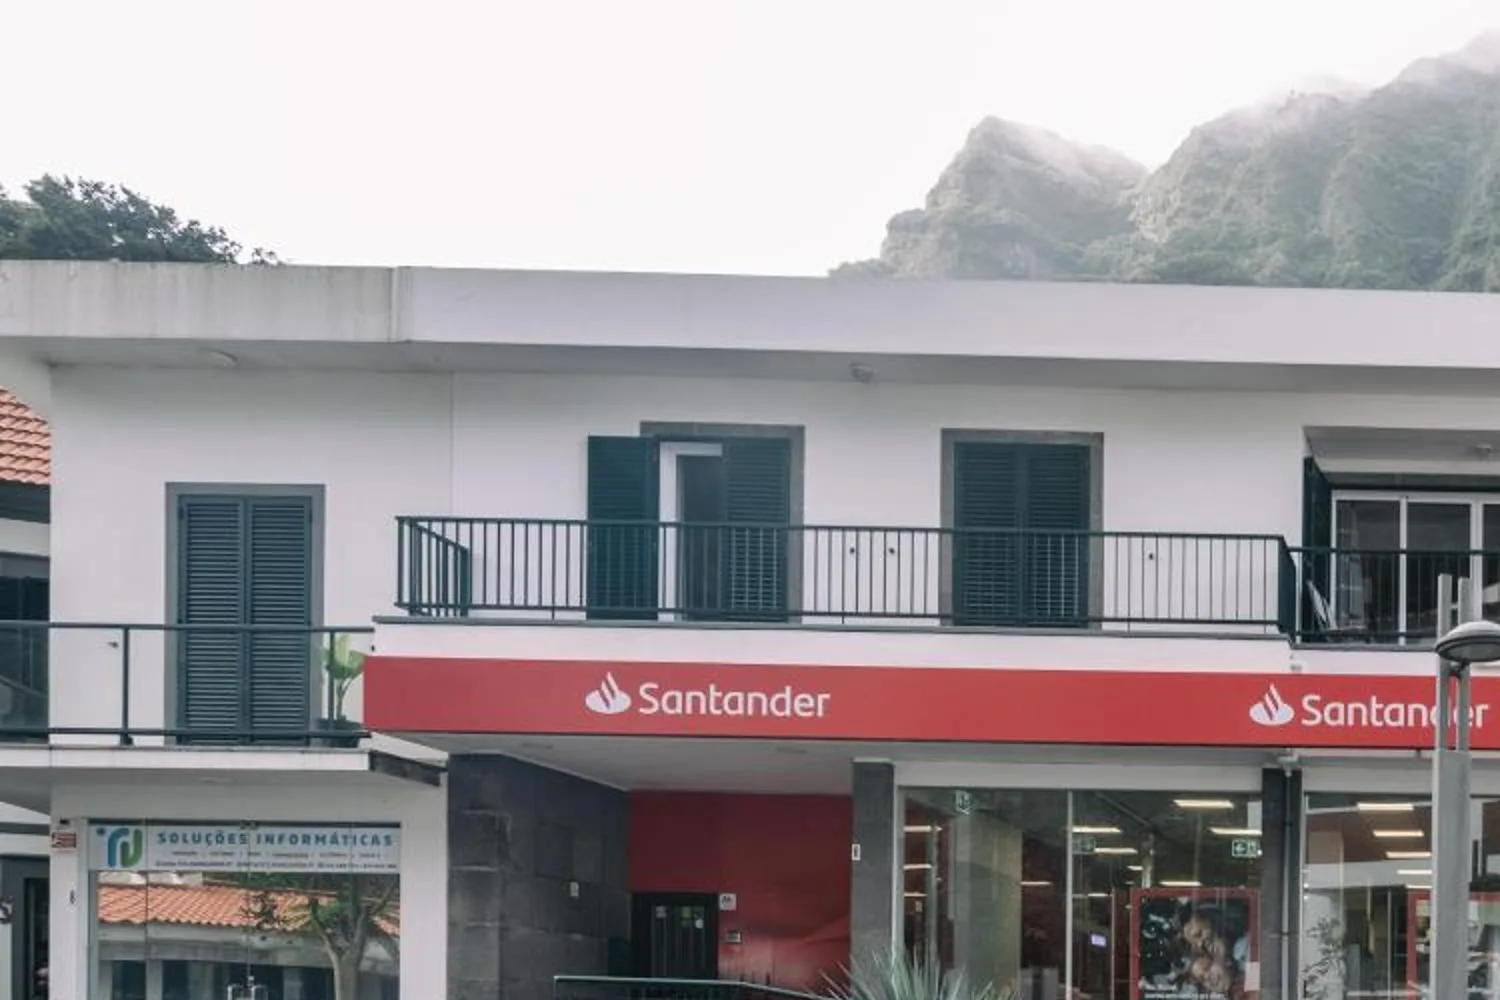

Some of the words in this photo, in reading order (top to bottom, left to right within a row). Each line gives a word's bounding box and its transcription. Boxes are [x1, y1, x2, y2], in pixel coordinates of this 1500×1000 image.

[638, 683, 831, 717] Santander
[157, 829, 249, 846] SOLUÇÕES
[256, 831, 393, 847] INFORMÁTICAS
